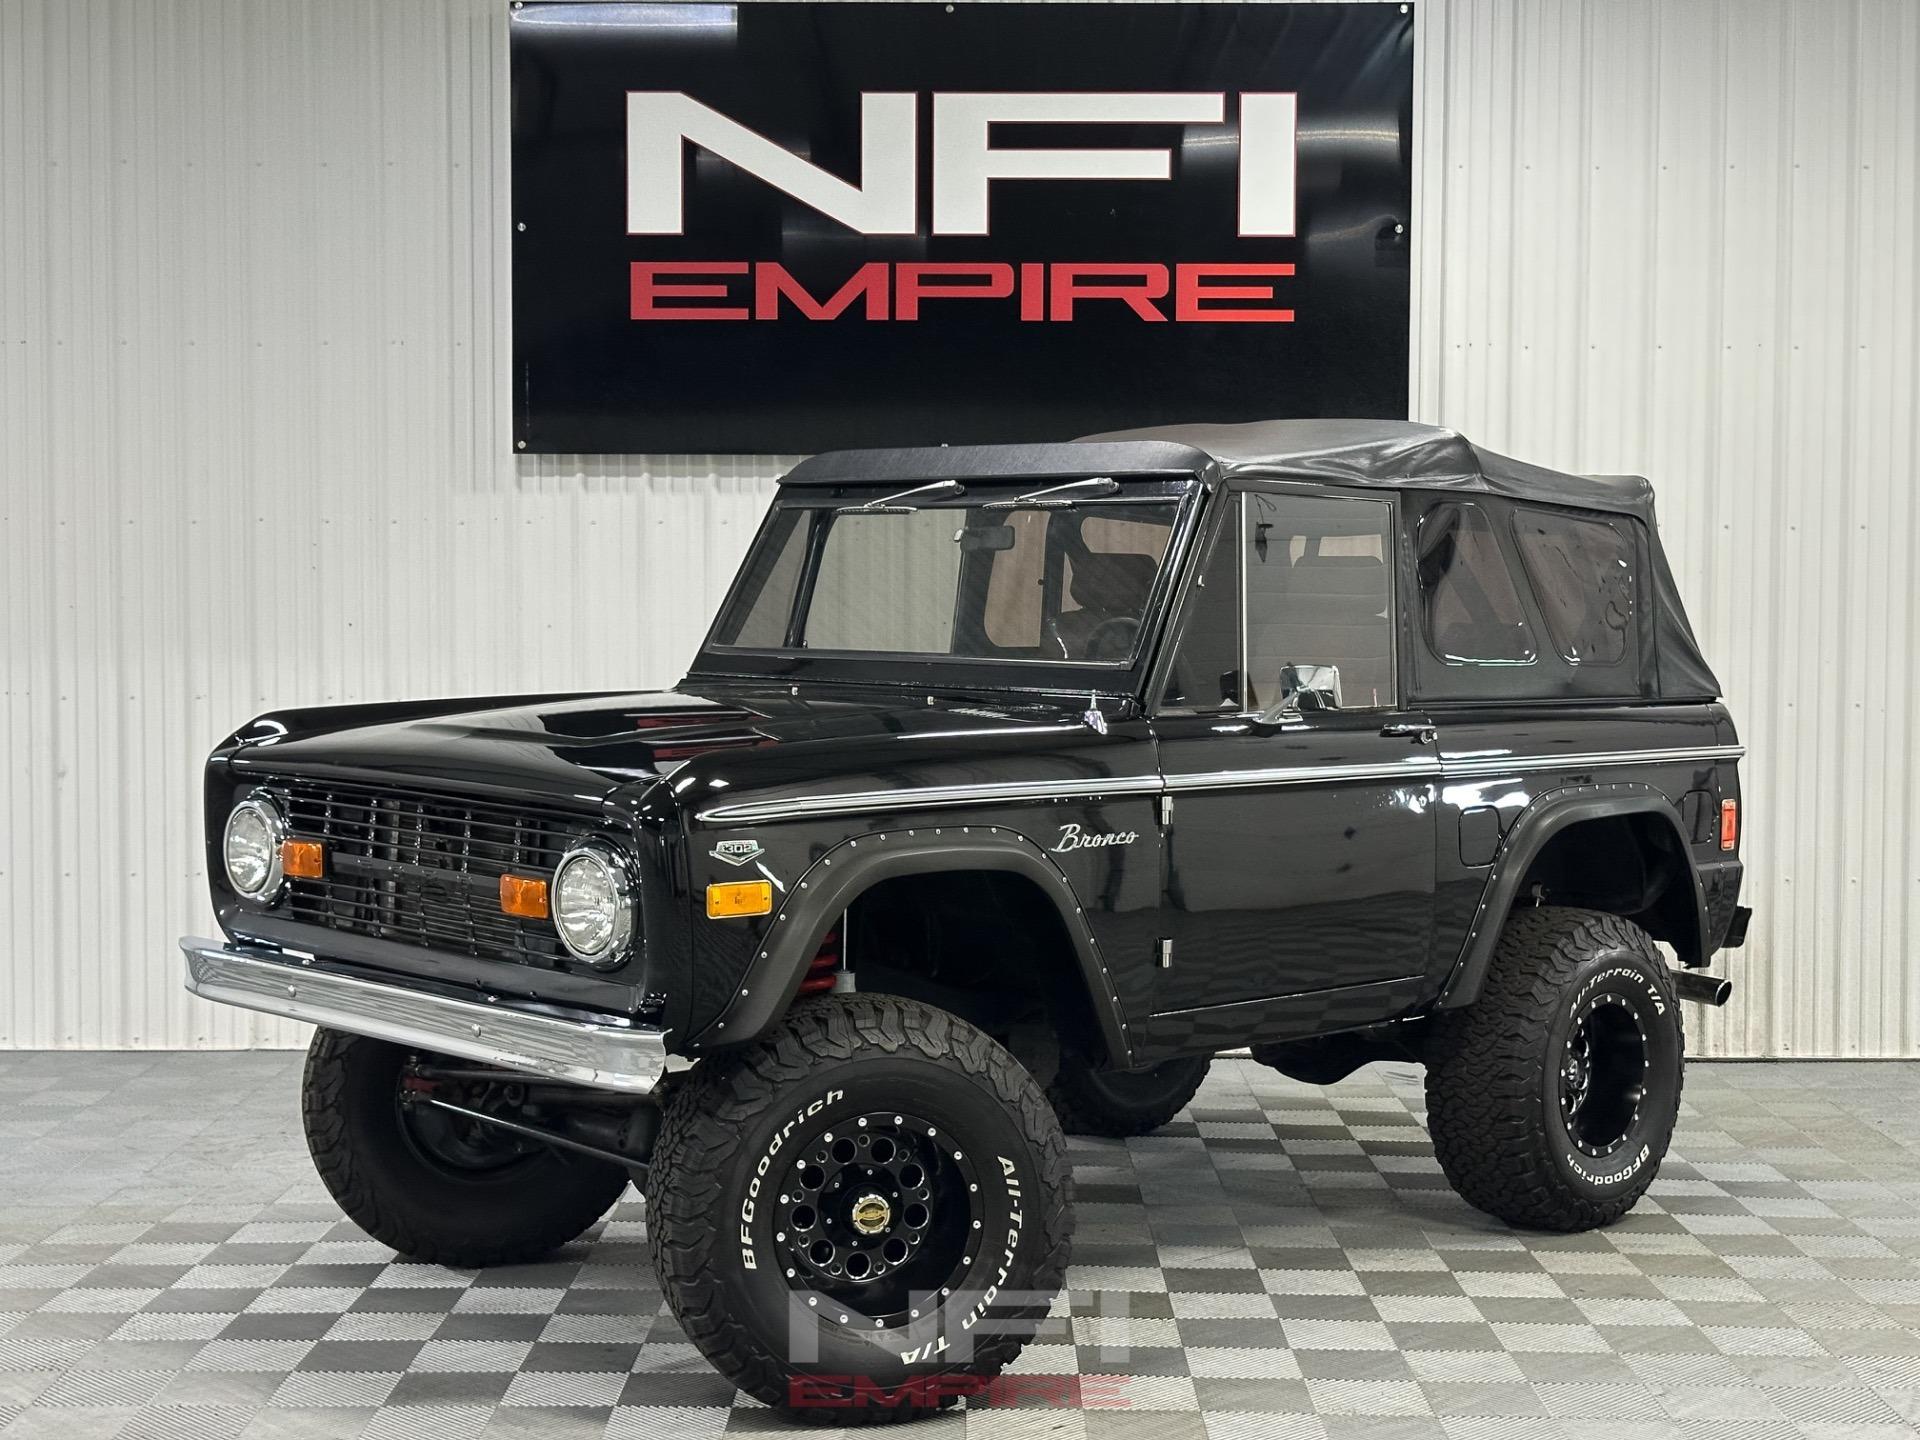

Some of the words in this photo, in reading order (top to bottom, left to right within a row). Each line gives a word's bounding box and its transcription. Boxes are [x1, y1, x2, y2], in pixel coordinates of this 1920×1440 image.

[626, 91, 1297, 237] NFI
[630, 262, 1295, 321] EMPIRE
[1048, 823, 1140, 853] Bronco
[1569, 967, 1645, 1019] All-Terrain
[1647, 983, 1666, 1016] T/A
[740, 1089, 844, 1270] BFGoodrich
[1566, 1143, 1650, 1186] BFGoodrich
[961, 1155, 1023, 1330] All-Terrain
[900, 1335, 951, 1365] T/A
